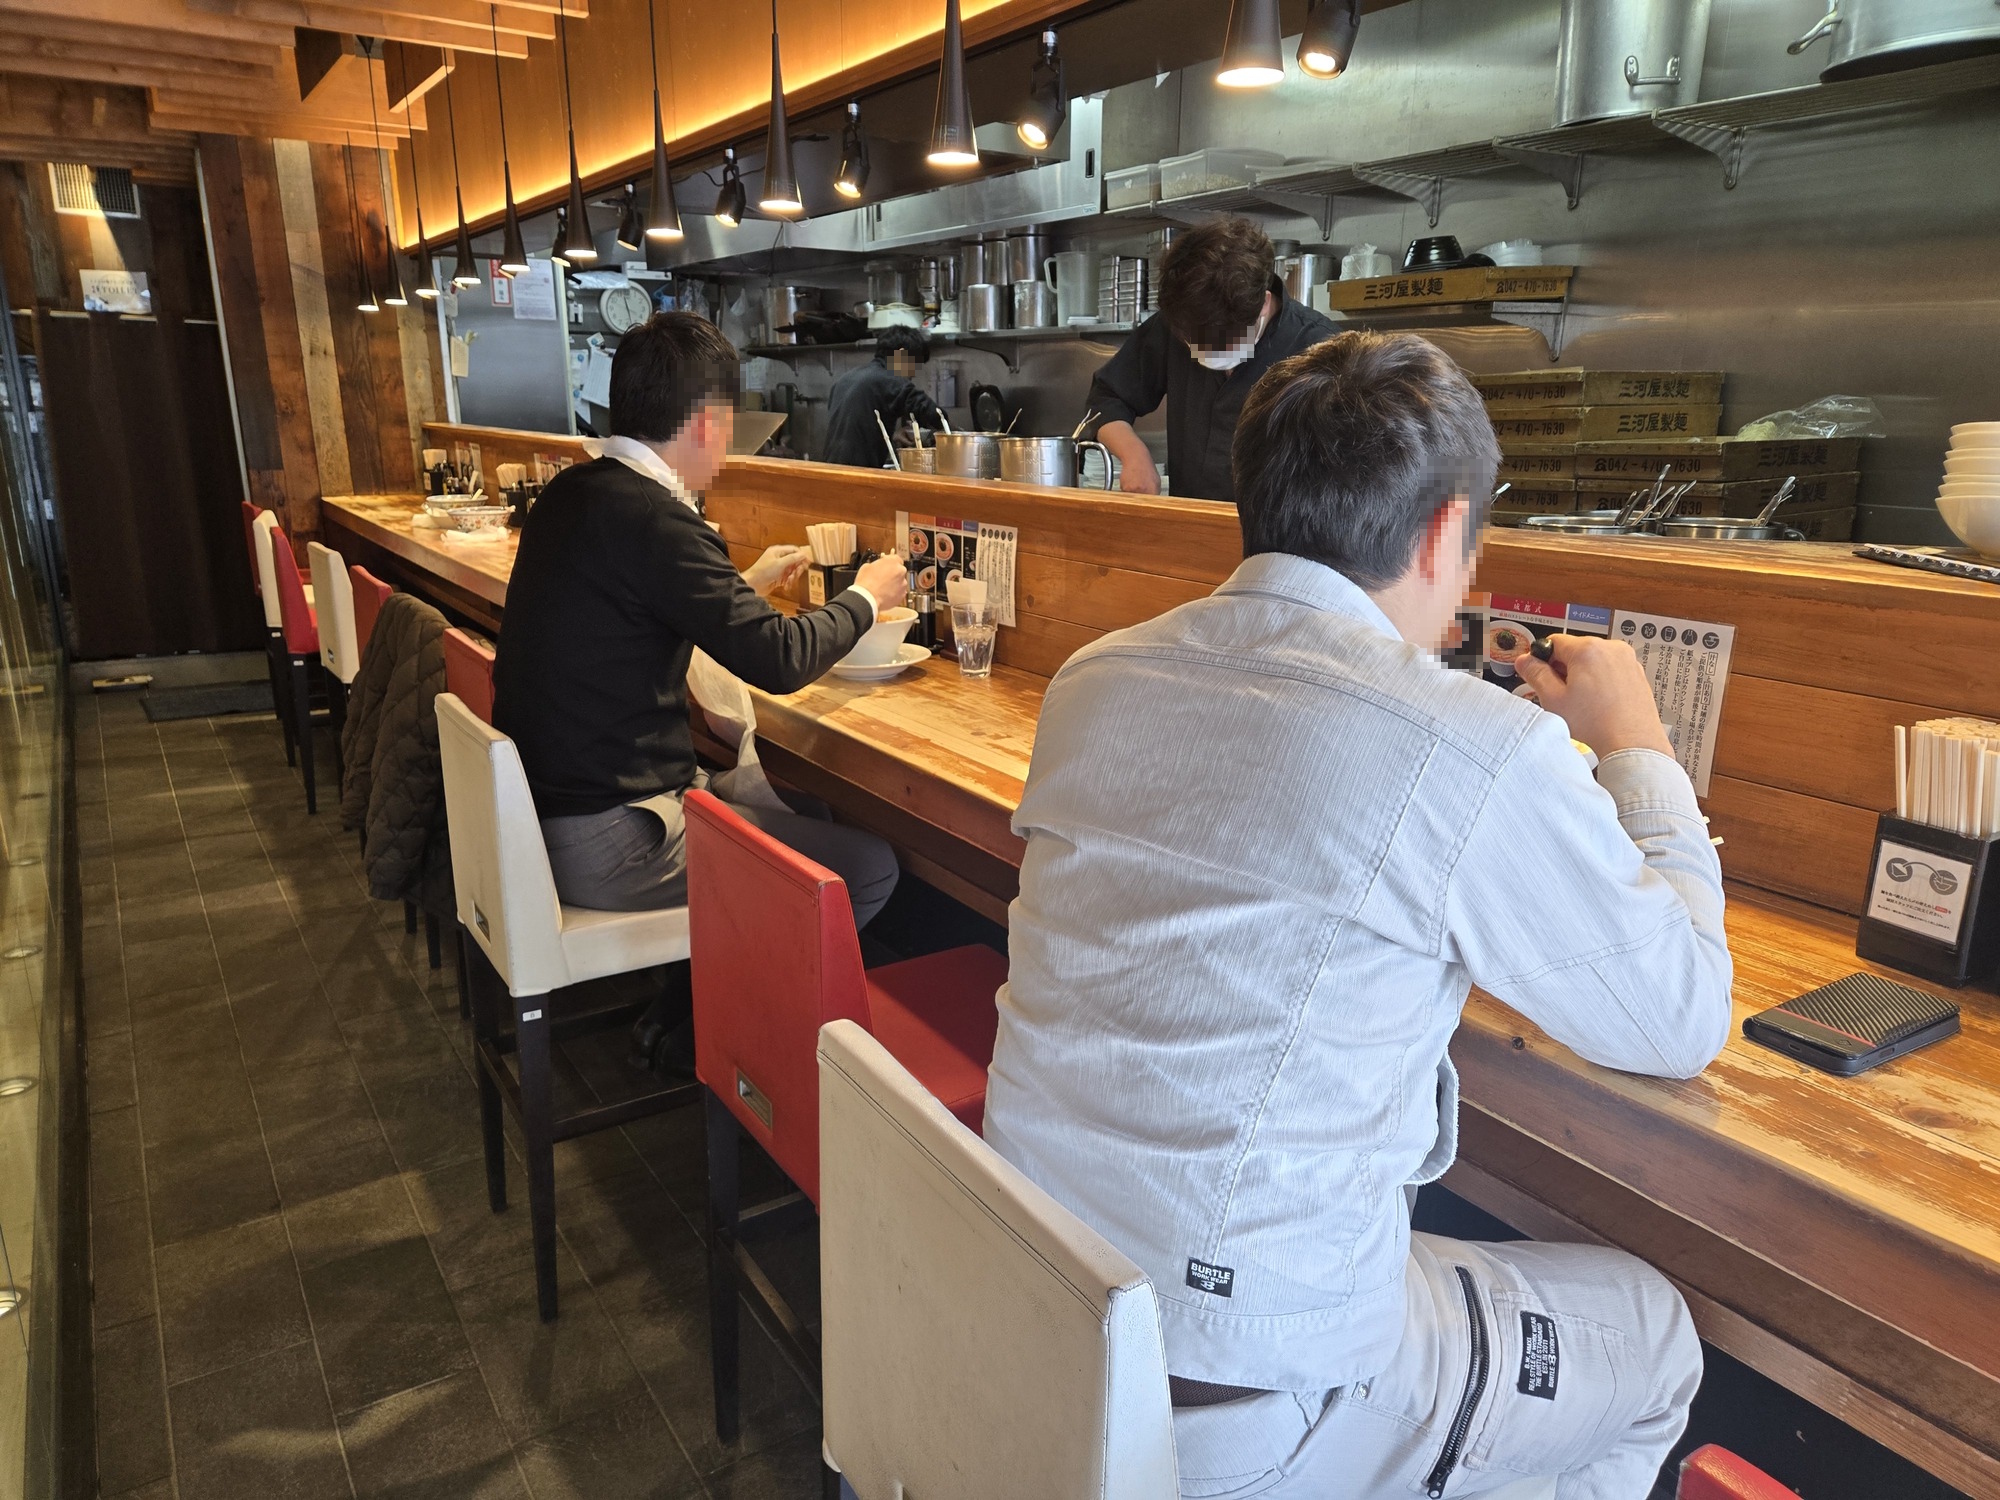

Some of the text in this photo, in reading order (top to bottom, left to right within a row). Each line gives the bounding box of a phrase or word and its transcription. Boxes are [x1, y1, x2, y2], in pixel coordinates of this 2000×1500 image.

[1364, 278, 1444, 300] 三河屋製麺
[1618, 378, 1690, 398] 三河屋製麺
[1617, 412, 1689, 433] 三河屋製麺
[1191, 1263, 1230, 1280] BURTLE
[1192, 1271, 1210, 1281] WORK
